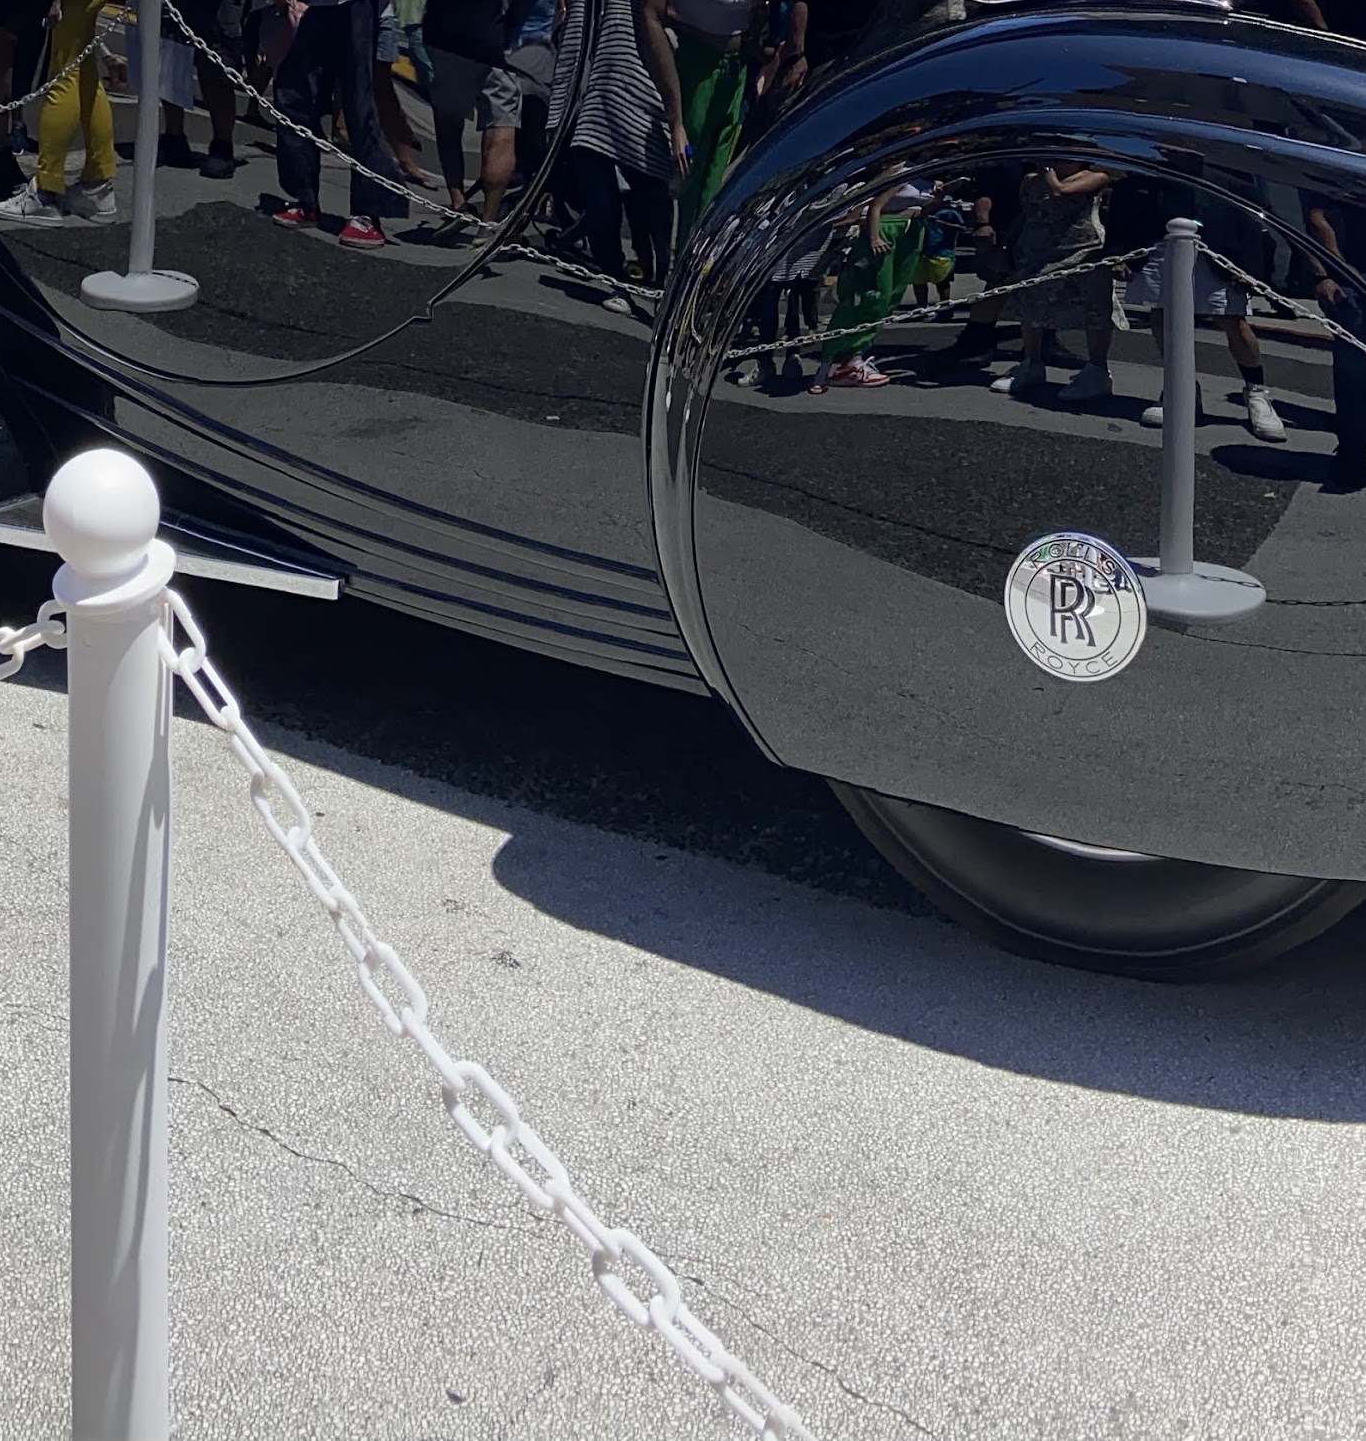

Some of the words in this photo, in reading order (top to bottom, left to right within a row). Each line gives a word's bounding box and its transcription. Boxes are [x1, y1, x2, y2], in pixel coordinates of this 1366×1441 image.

[1029, 542, 1116, 576] ROLLS
[1050, 574, 1097, 648] RR
[1030, 641, 1118, 675] ROYCE
